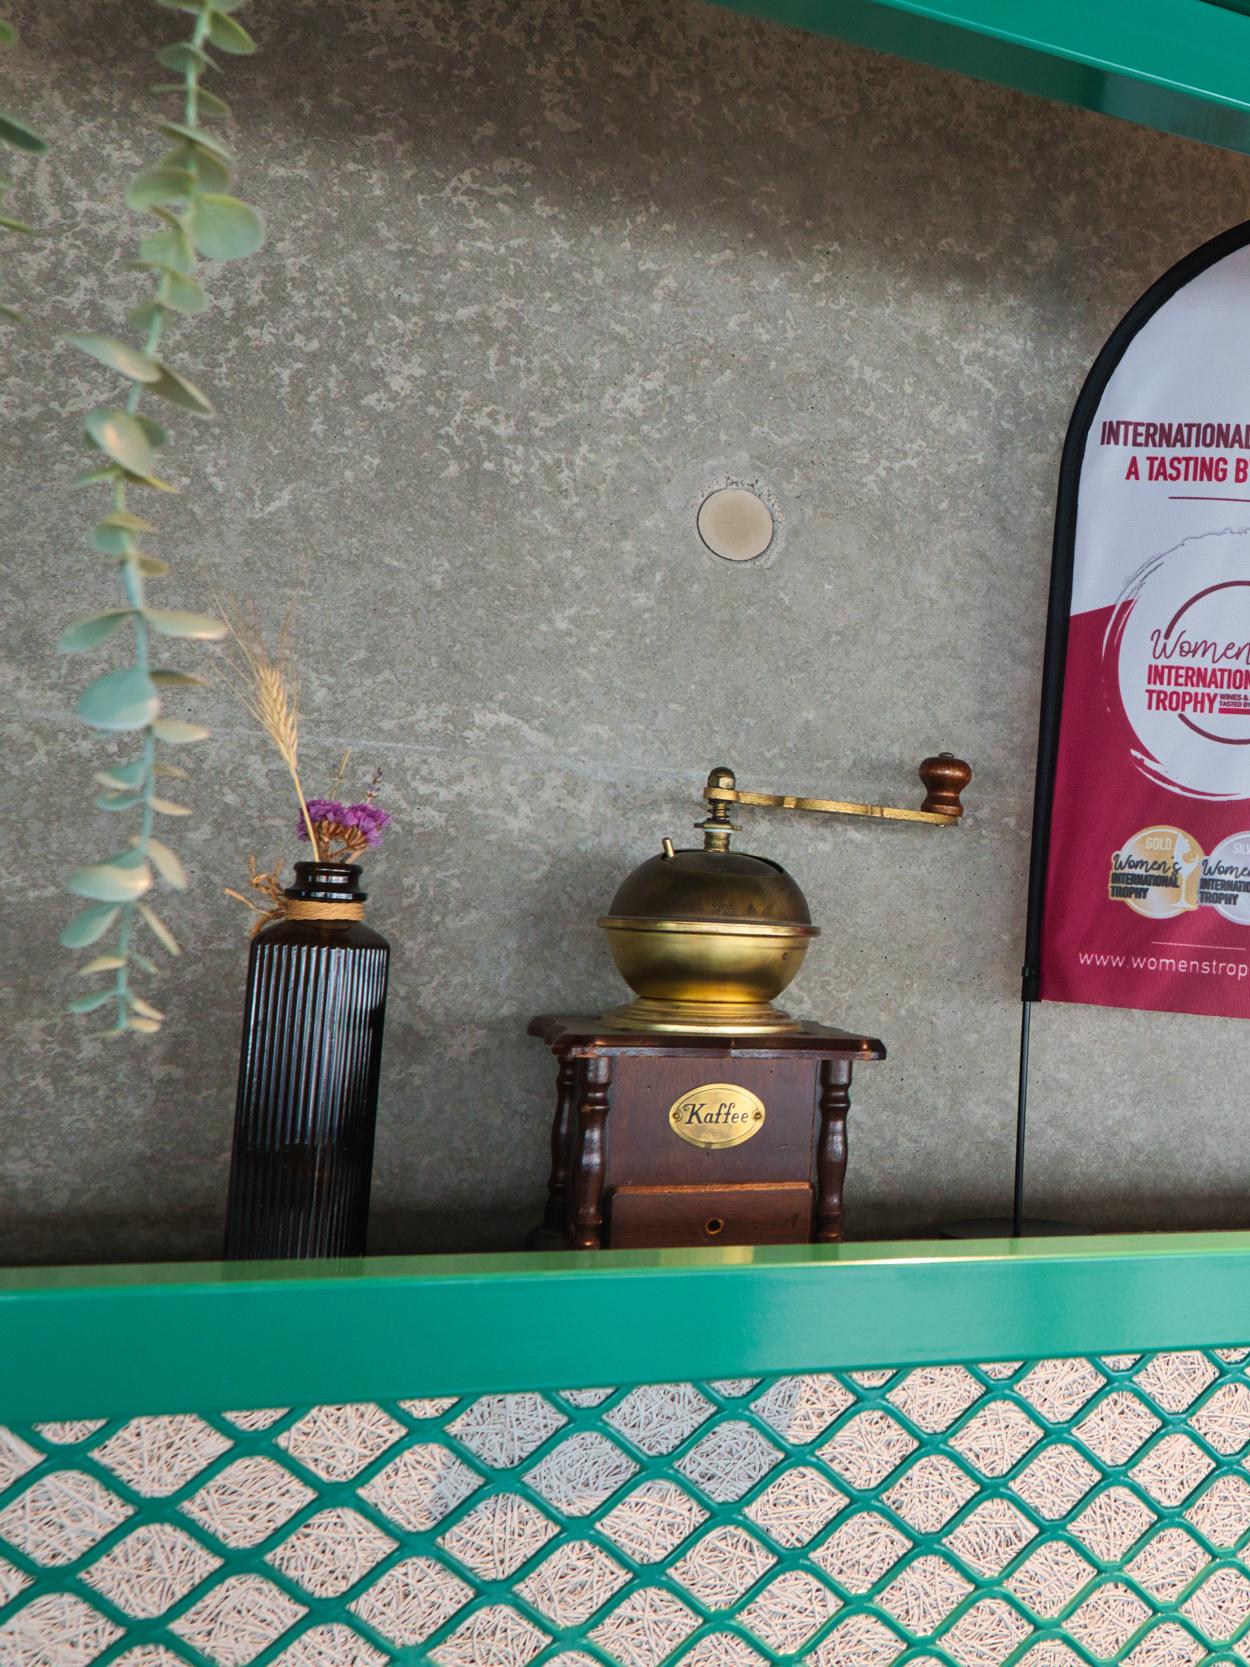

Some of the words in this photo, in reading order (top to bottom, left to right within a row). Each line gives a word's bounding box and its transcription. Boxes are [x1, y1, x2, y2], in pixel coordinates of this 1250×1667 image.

[1124, 455, 1140, 481] A
[1146, 456, 1229, 483] TASTING
[1144, 688, 1219, 714] TROPHY
[1145, 837, 1172, 851] GOLD
[1113, 853, 1182, 876] Women's
[1110, 872, 1181, 888] INTERNATIONAL
[1109, 885, 1150, 899] TROPHY
[1198, 890, 1239, 906] TROPHY
[682, 1102, 749, 1124] Kaffee
